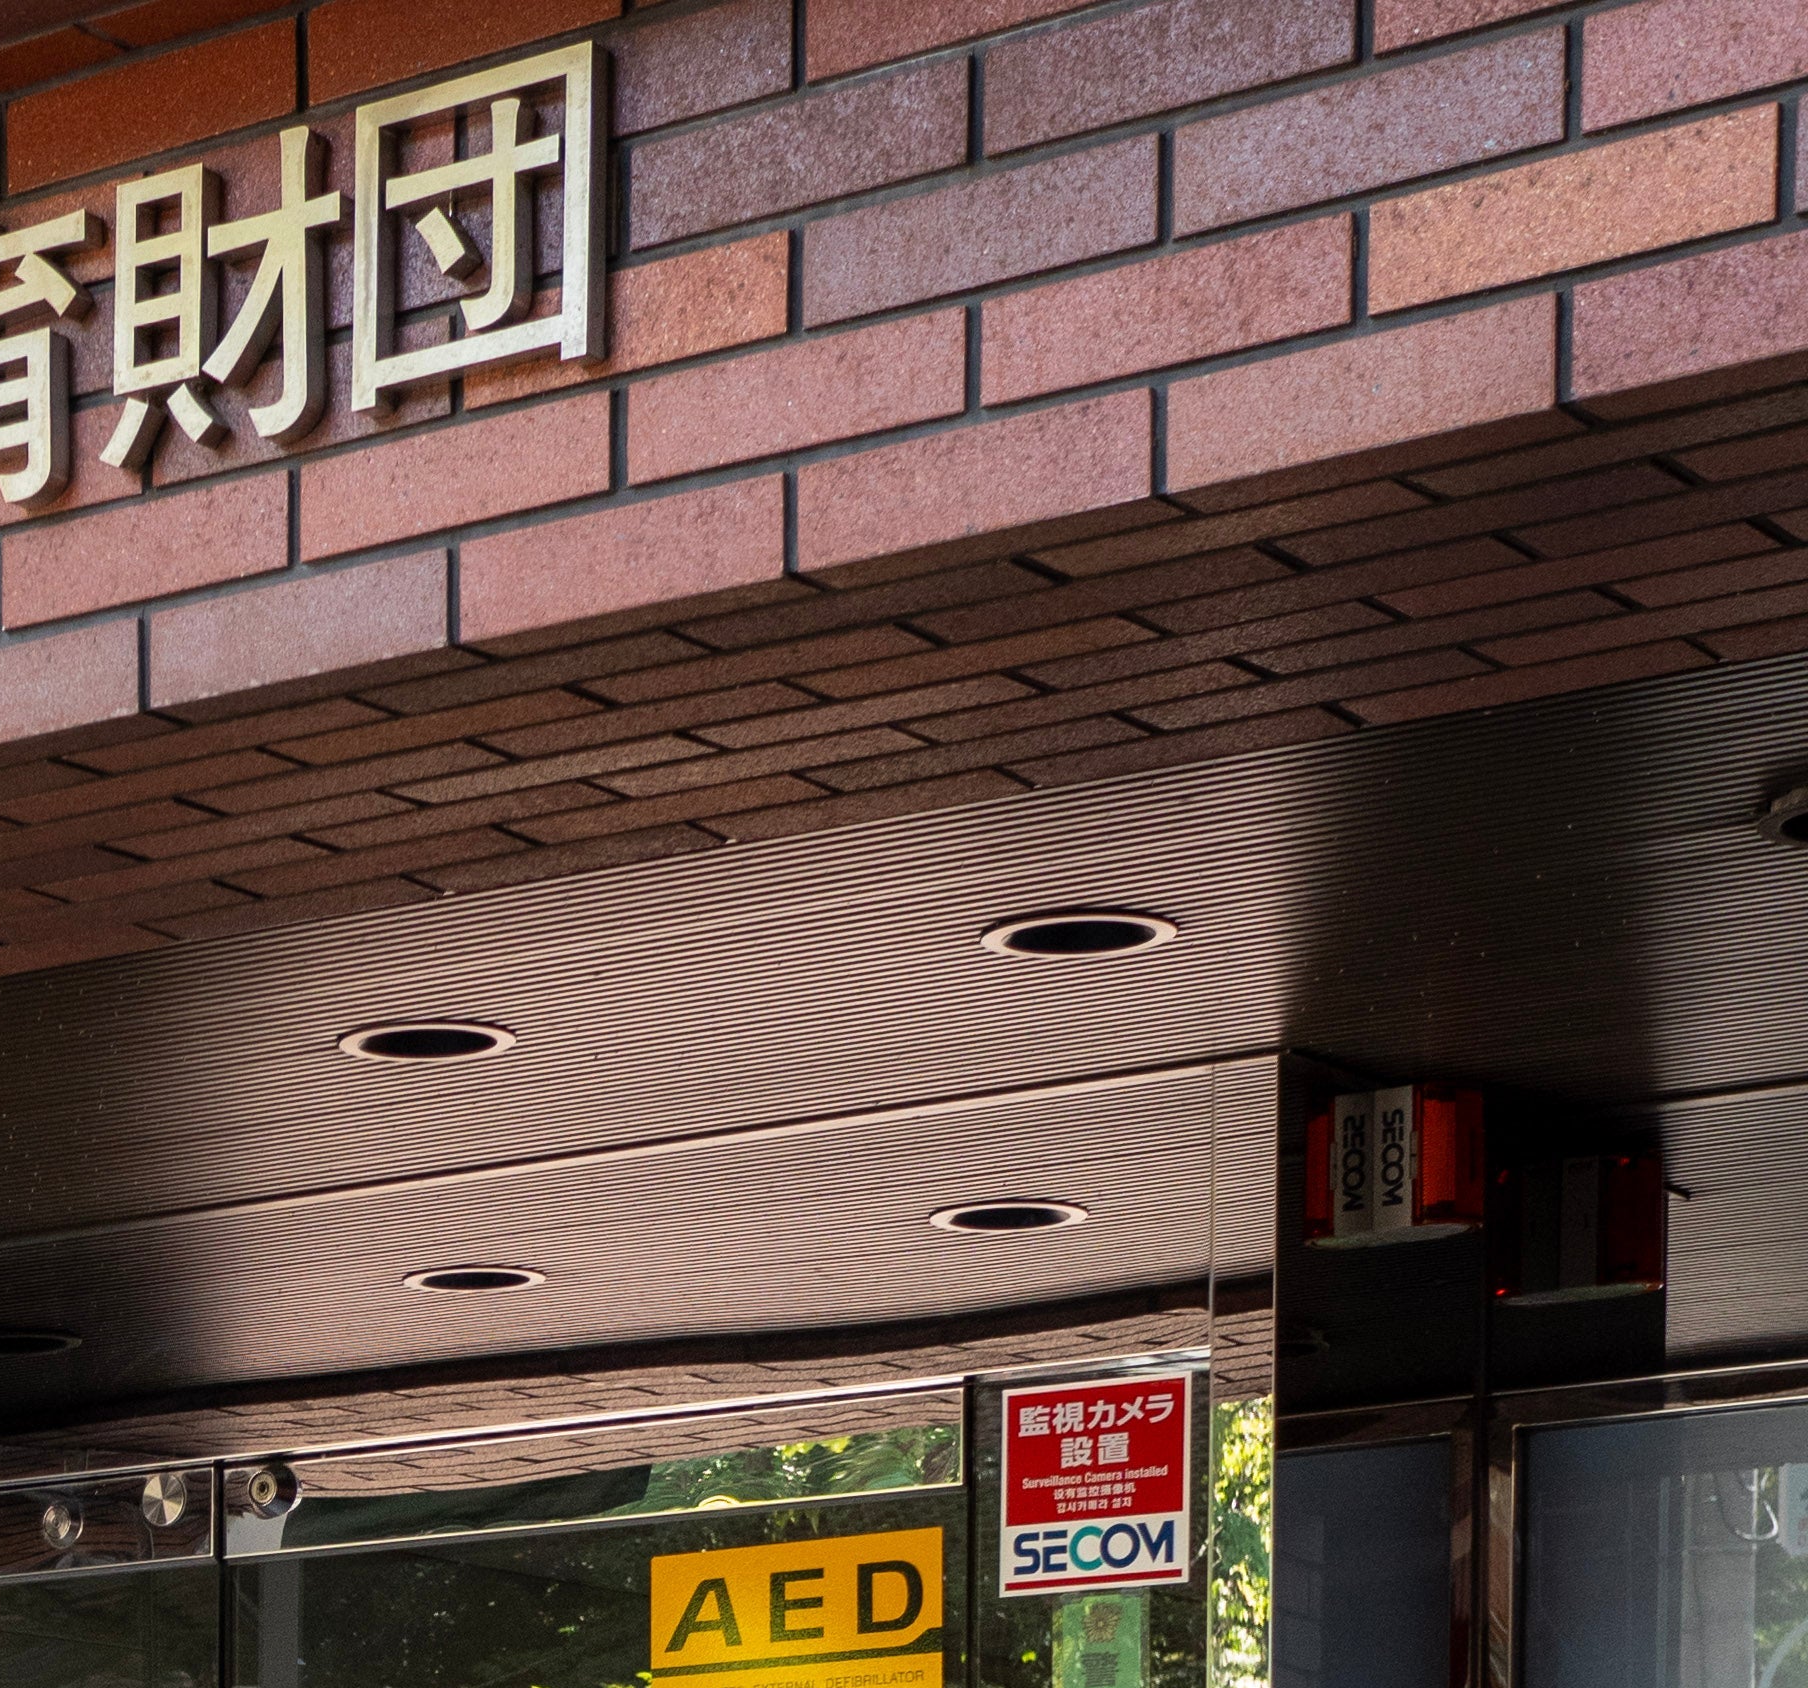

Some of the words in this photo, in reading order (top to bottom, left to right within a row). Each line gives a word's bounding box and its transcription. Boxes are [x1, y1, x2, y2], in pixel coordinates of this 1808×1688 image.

[1381, 1108, 1405, 1207] SECOM
[1018, 1393, 1175, 1438] 監視カメラ
[1060, 1432, 1130, 1469] 設置
[1022, 1474, 1082, 1490] Surveillance
[1084, 1470, 1123, 1483] Camera
[1124, 1464, 1169, 1480] installed
[1013, 1519, 1175, 1576] SECOM
[664, 1559, 924, 1654] AED
